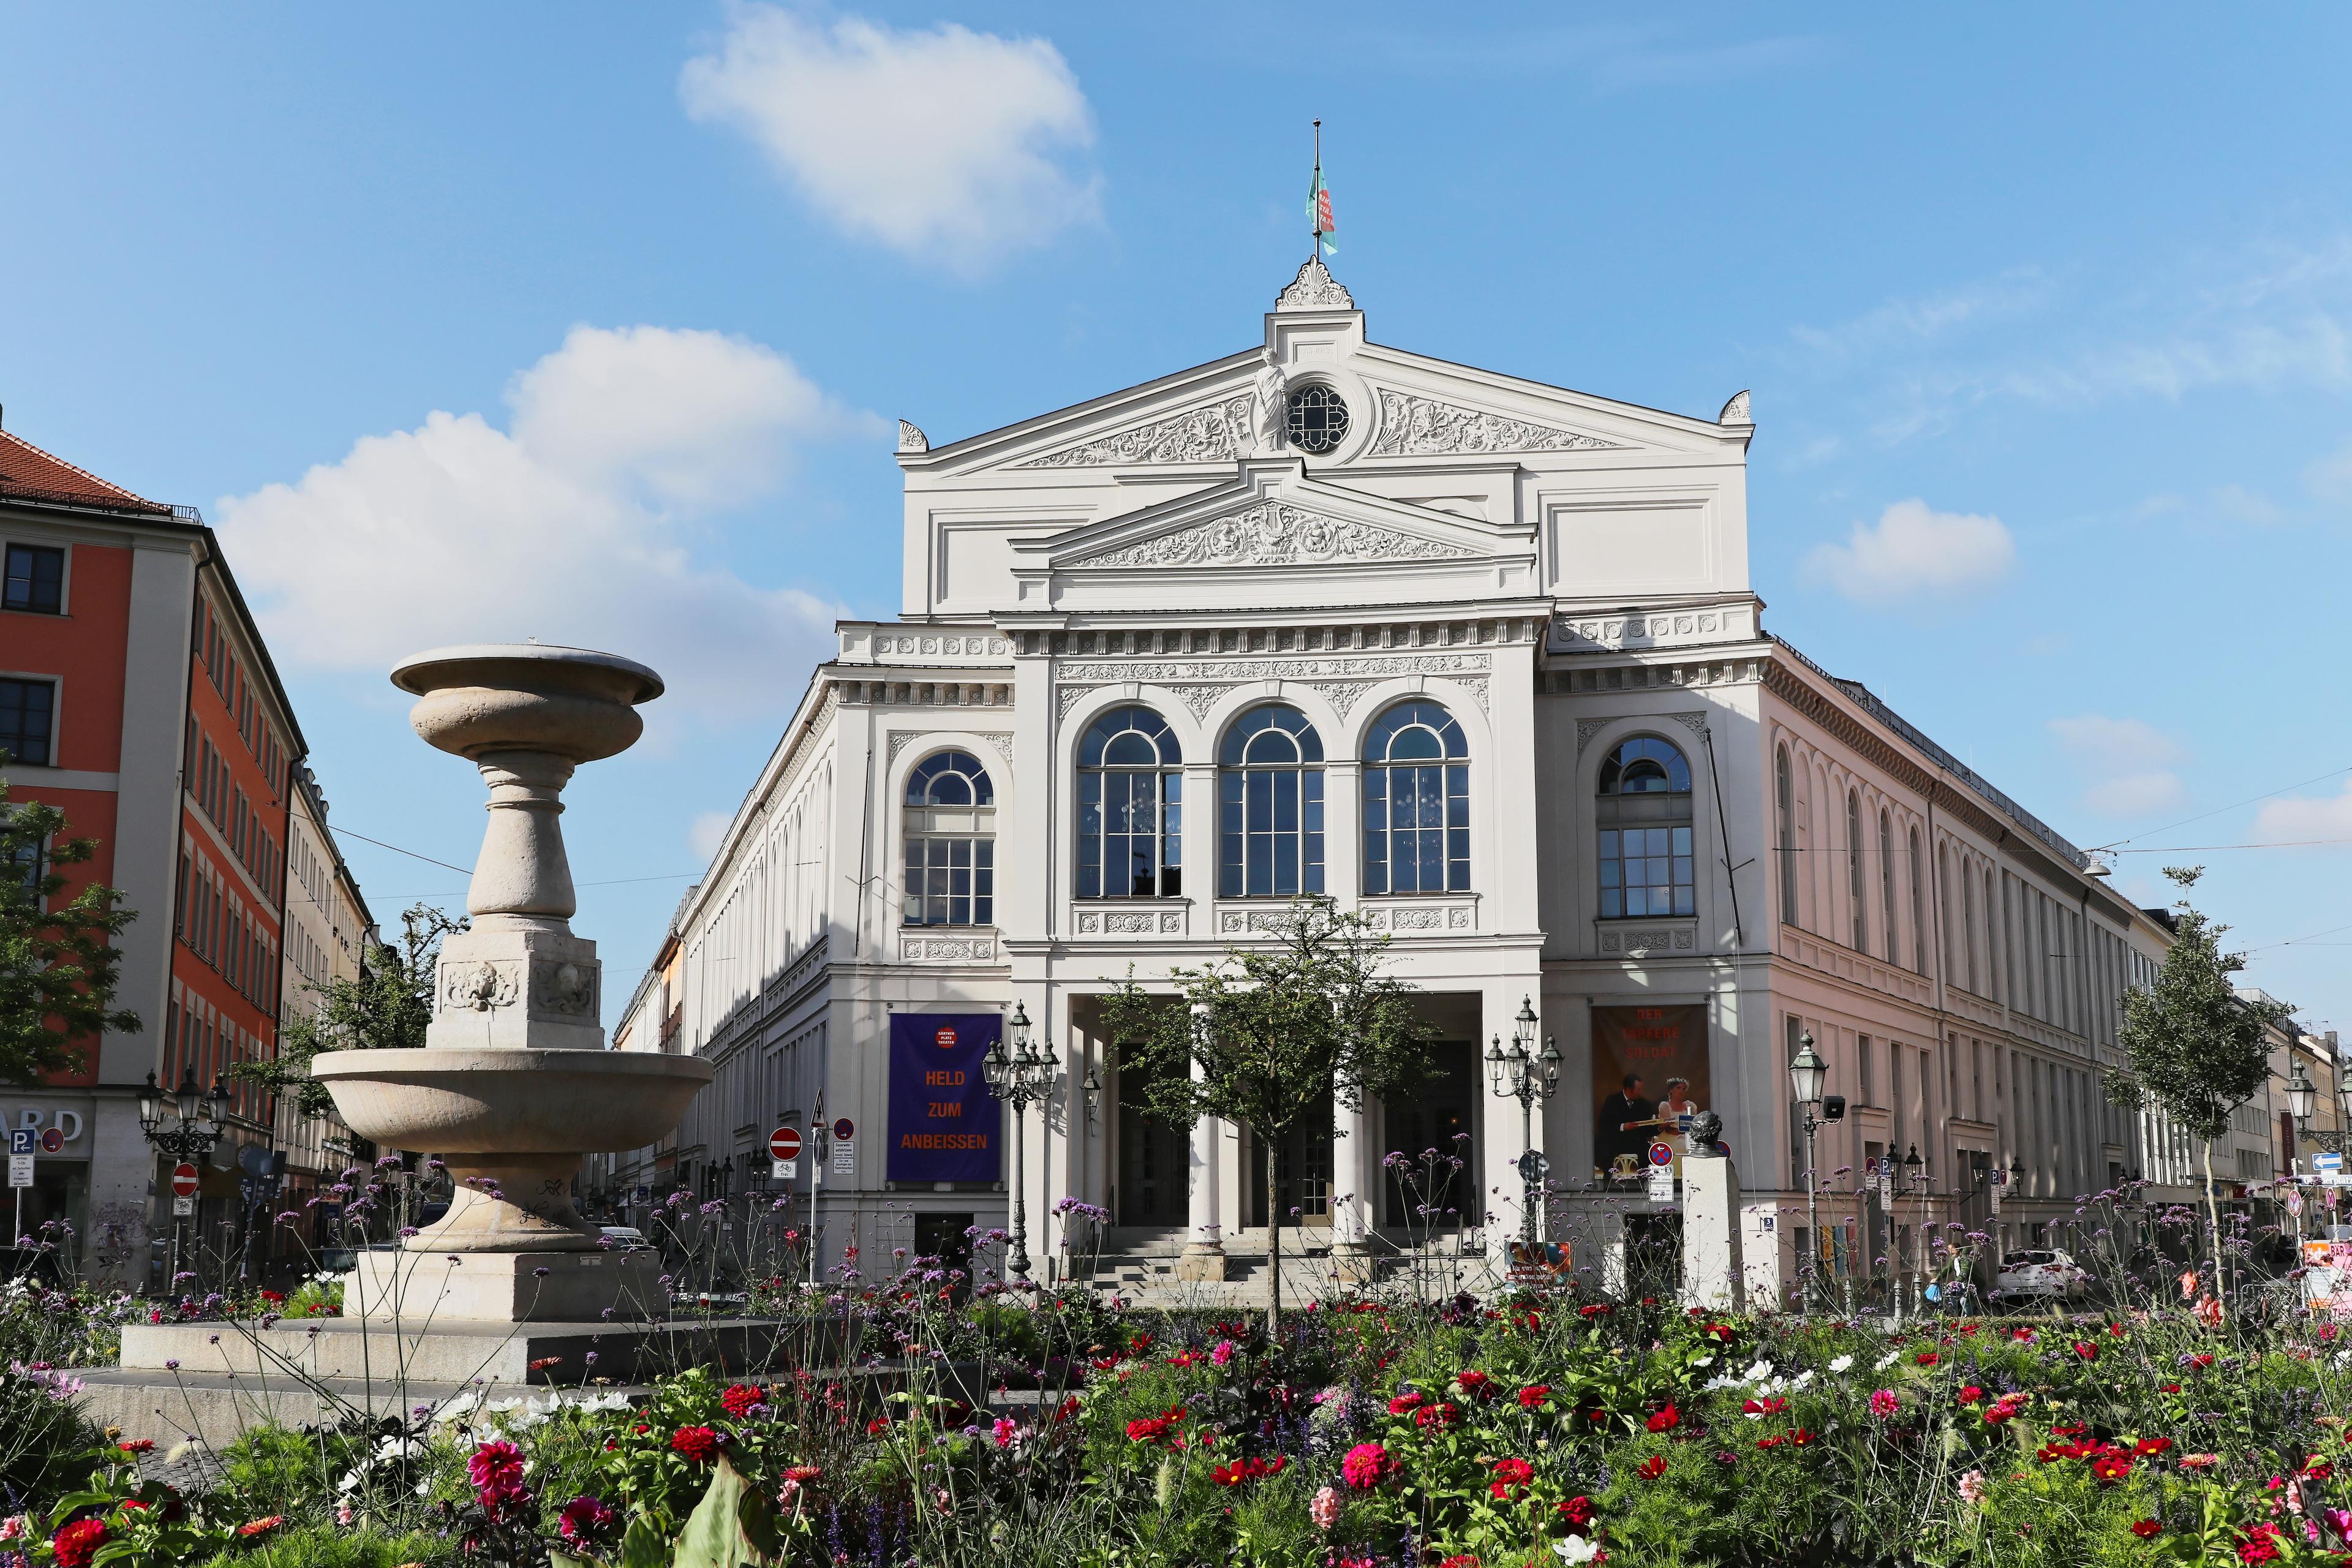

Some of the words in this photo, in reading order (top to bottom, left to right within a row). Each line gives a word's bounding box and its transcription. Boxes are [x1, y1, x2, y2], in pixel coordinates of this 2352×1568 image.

[1637, 1009, 1662, 1020] DER
[1621, 1027, 1680, 1039] TAPFERE
[1626, 1047, 1676, 1059] SOLDAT
[925, 1071, 965, 1085] HELD
[928, 1103, 961, 1117] ZUM
[901, 1134, 987, 1149] ANBEISSEN
[2304, 1176, 2352, 1186] Gänerplatz
